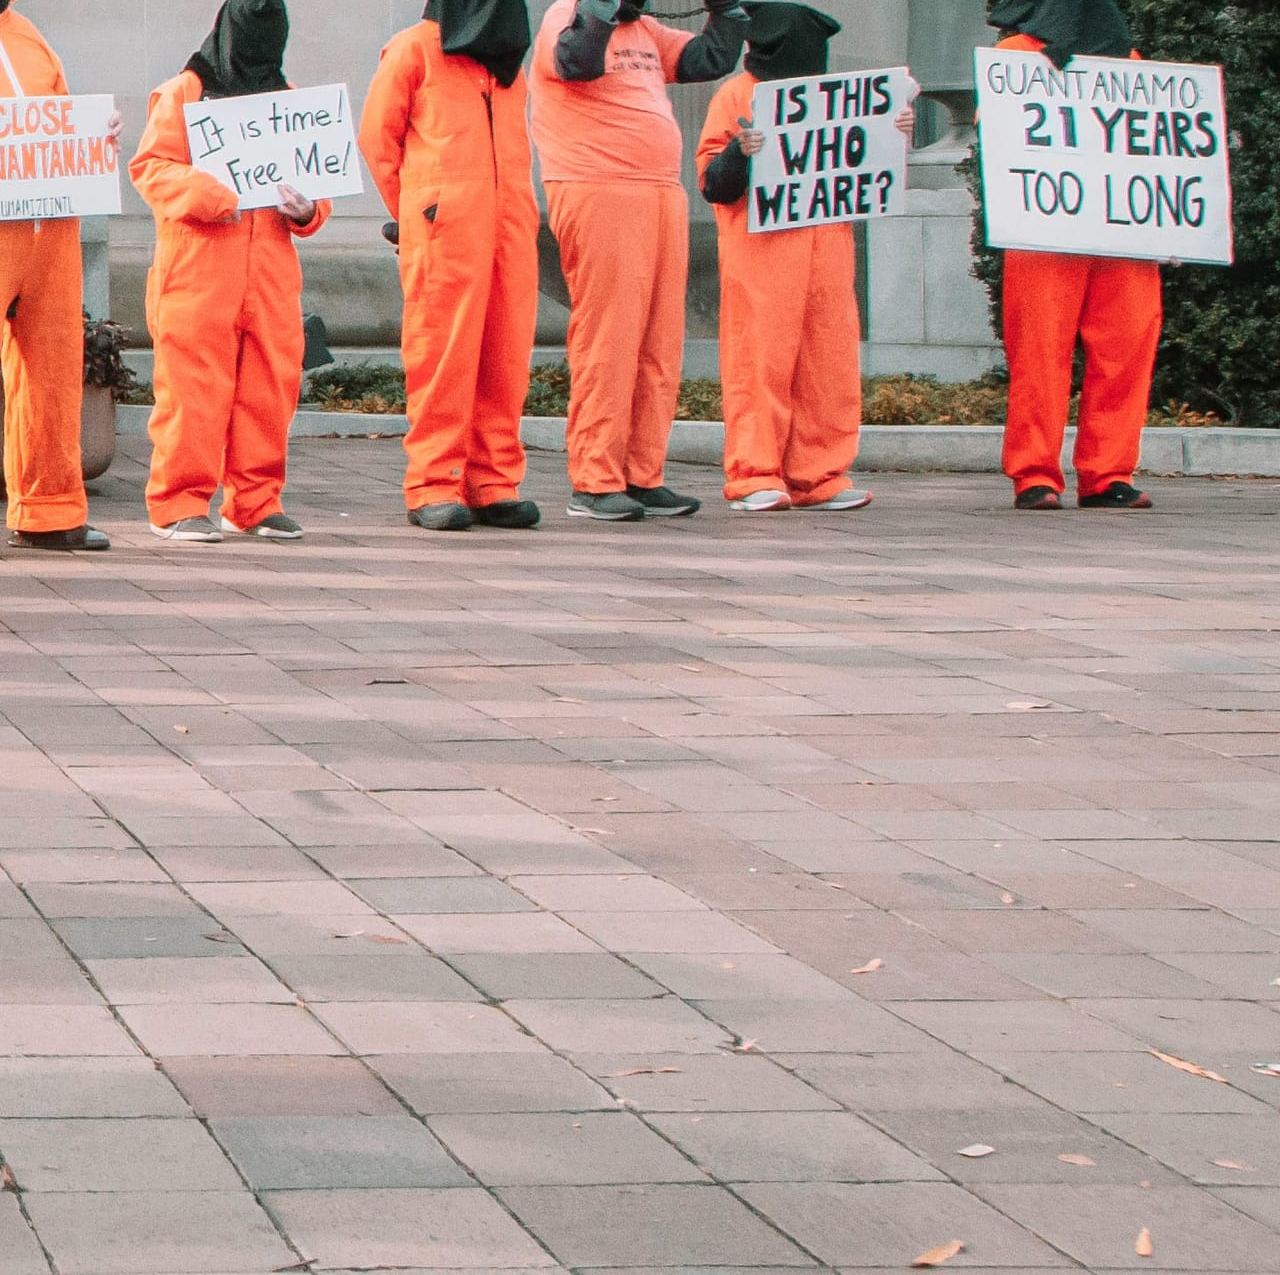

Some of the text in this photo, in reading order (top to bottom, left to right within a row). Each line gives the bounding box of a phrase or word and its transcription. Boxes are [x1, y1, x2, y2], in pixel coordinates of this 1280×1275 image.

[189, 89, 342, 158] It is time!
[774, 75, 892, 126] IS THIS
[778, 125, 867, 176] WHO
[1022, 103, 1218, 158] 21 YEARS
[225, 140, 351, 194] Free Me!
[754, 170, 894, 226] WE ARE?
[1008, 168, 1206, 228] TOO LONG
